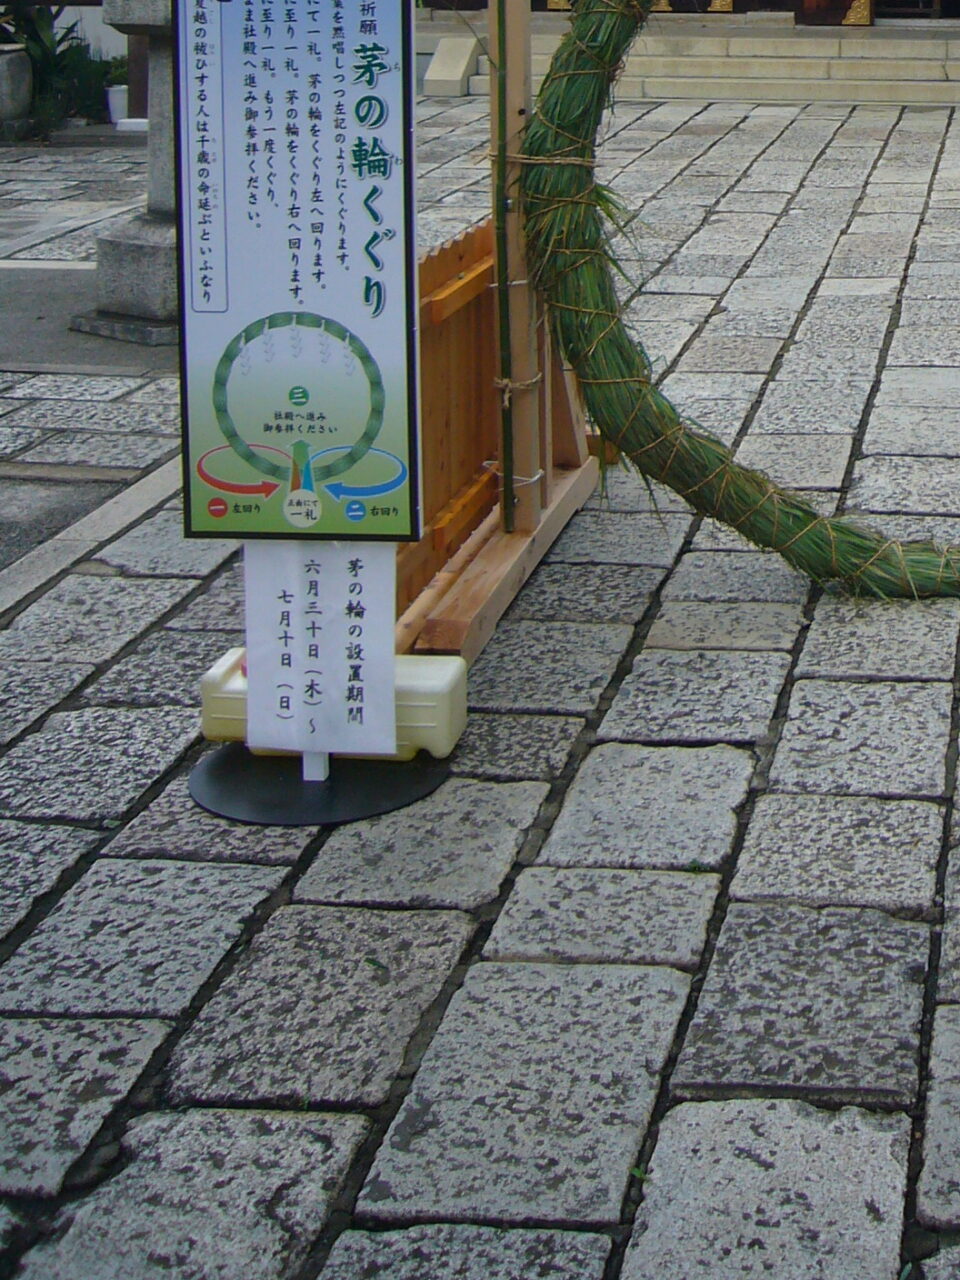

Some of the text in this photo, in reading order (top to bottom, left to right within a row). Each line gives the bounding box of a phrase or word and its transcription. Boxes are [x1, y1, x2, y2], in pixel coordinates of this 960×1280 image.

[351, 42, 396, 318] 茅の輪くぐり
[232, 503, 261, 514] 左回り
[290, 508, 318, 521] 一礼
[370, 506, 399, 517] 右回り
[345, 559, 367, 726] 茅の輪の設置期間
